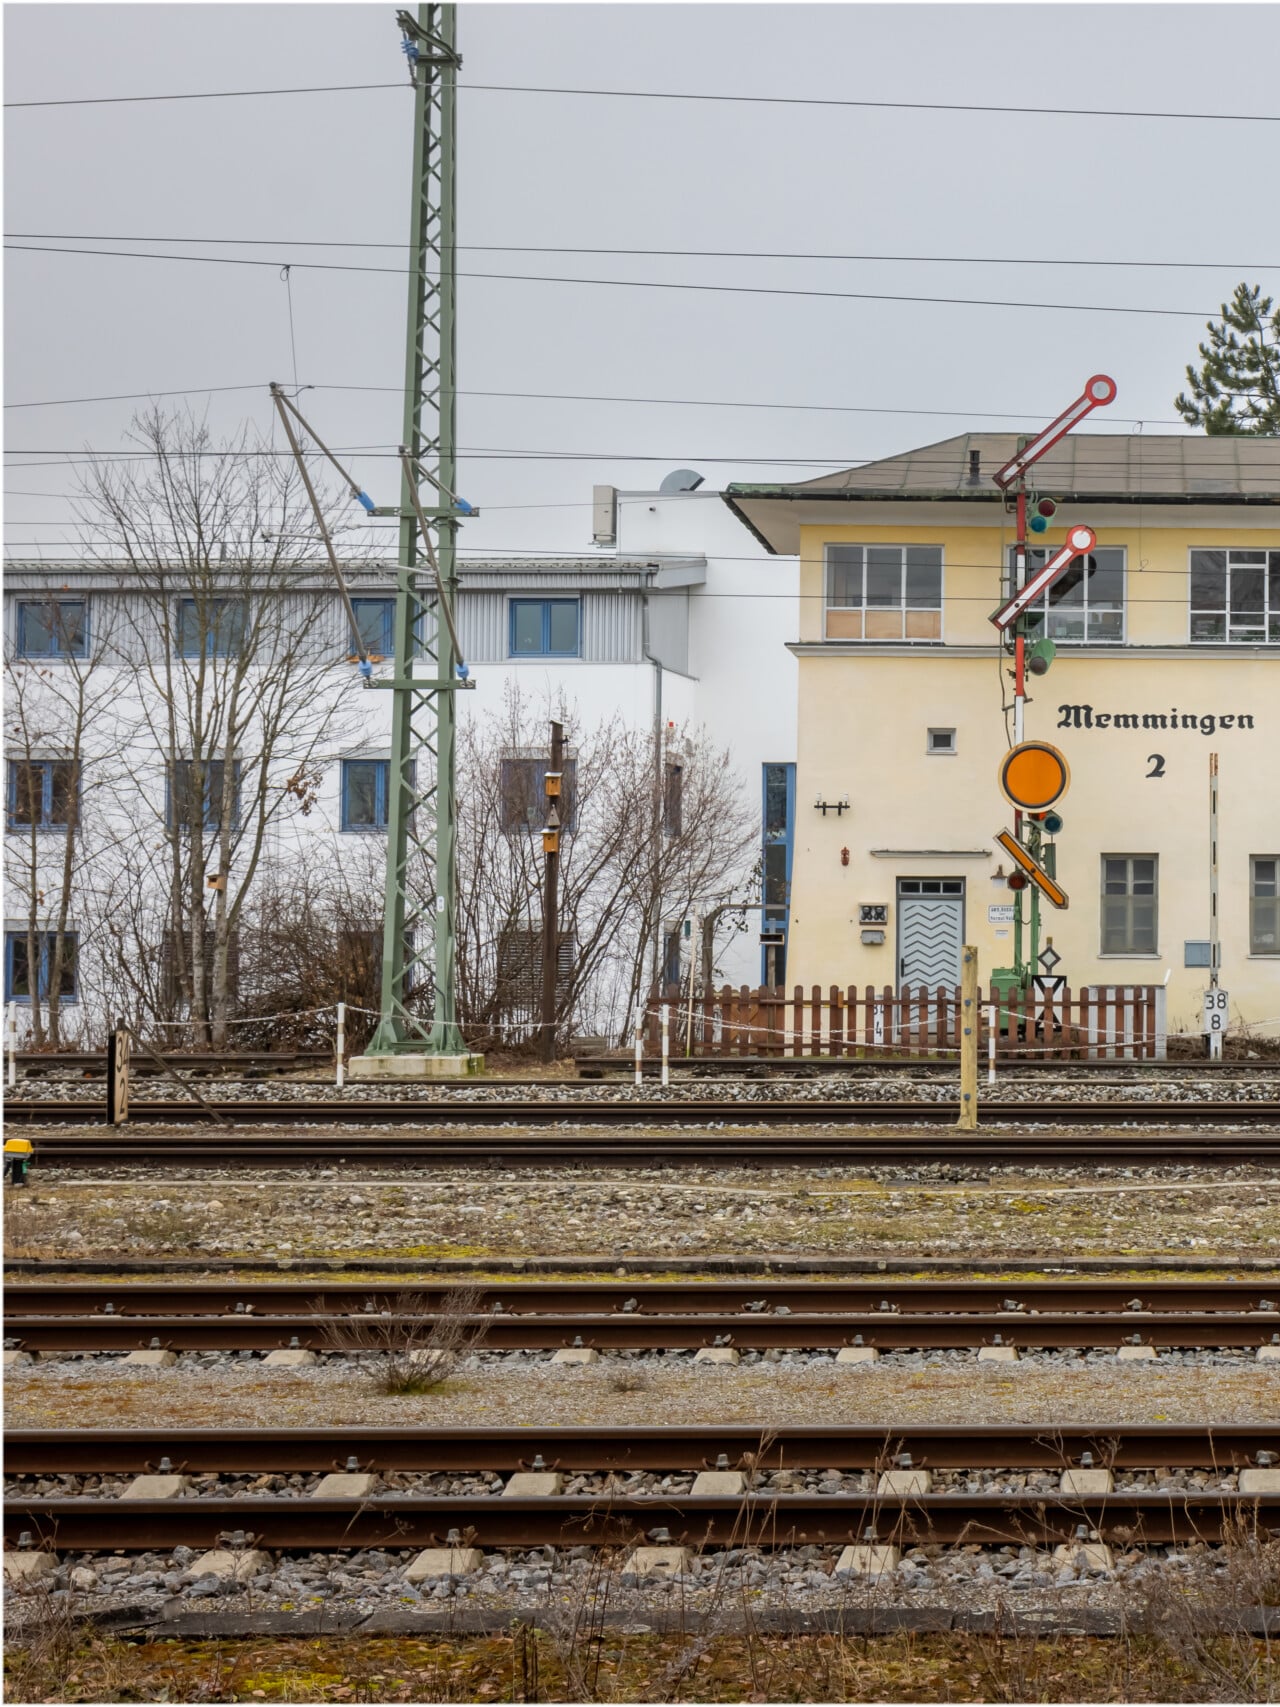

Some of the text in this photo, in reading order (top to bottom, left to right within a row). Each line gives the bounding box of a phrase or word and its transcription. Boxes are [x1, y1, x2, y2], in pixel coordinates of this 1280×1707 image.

[1057, 704, 1255, 736] Memmingen
[1145, 753, 1166, 778] 2
[1205, 992, 1227, 1010] 38
[1211, 1013, 1221, 1030] 8
[119, 1077, 126, 1115] 2
